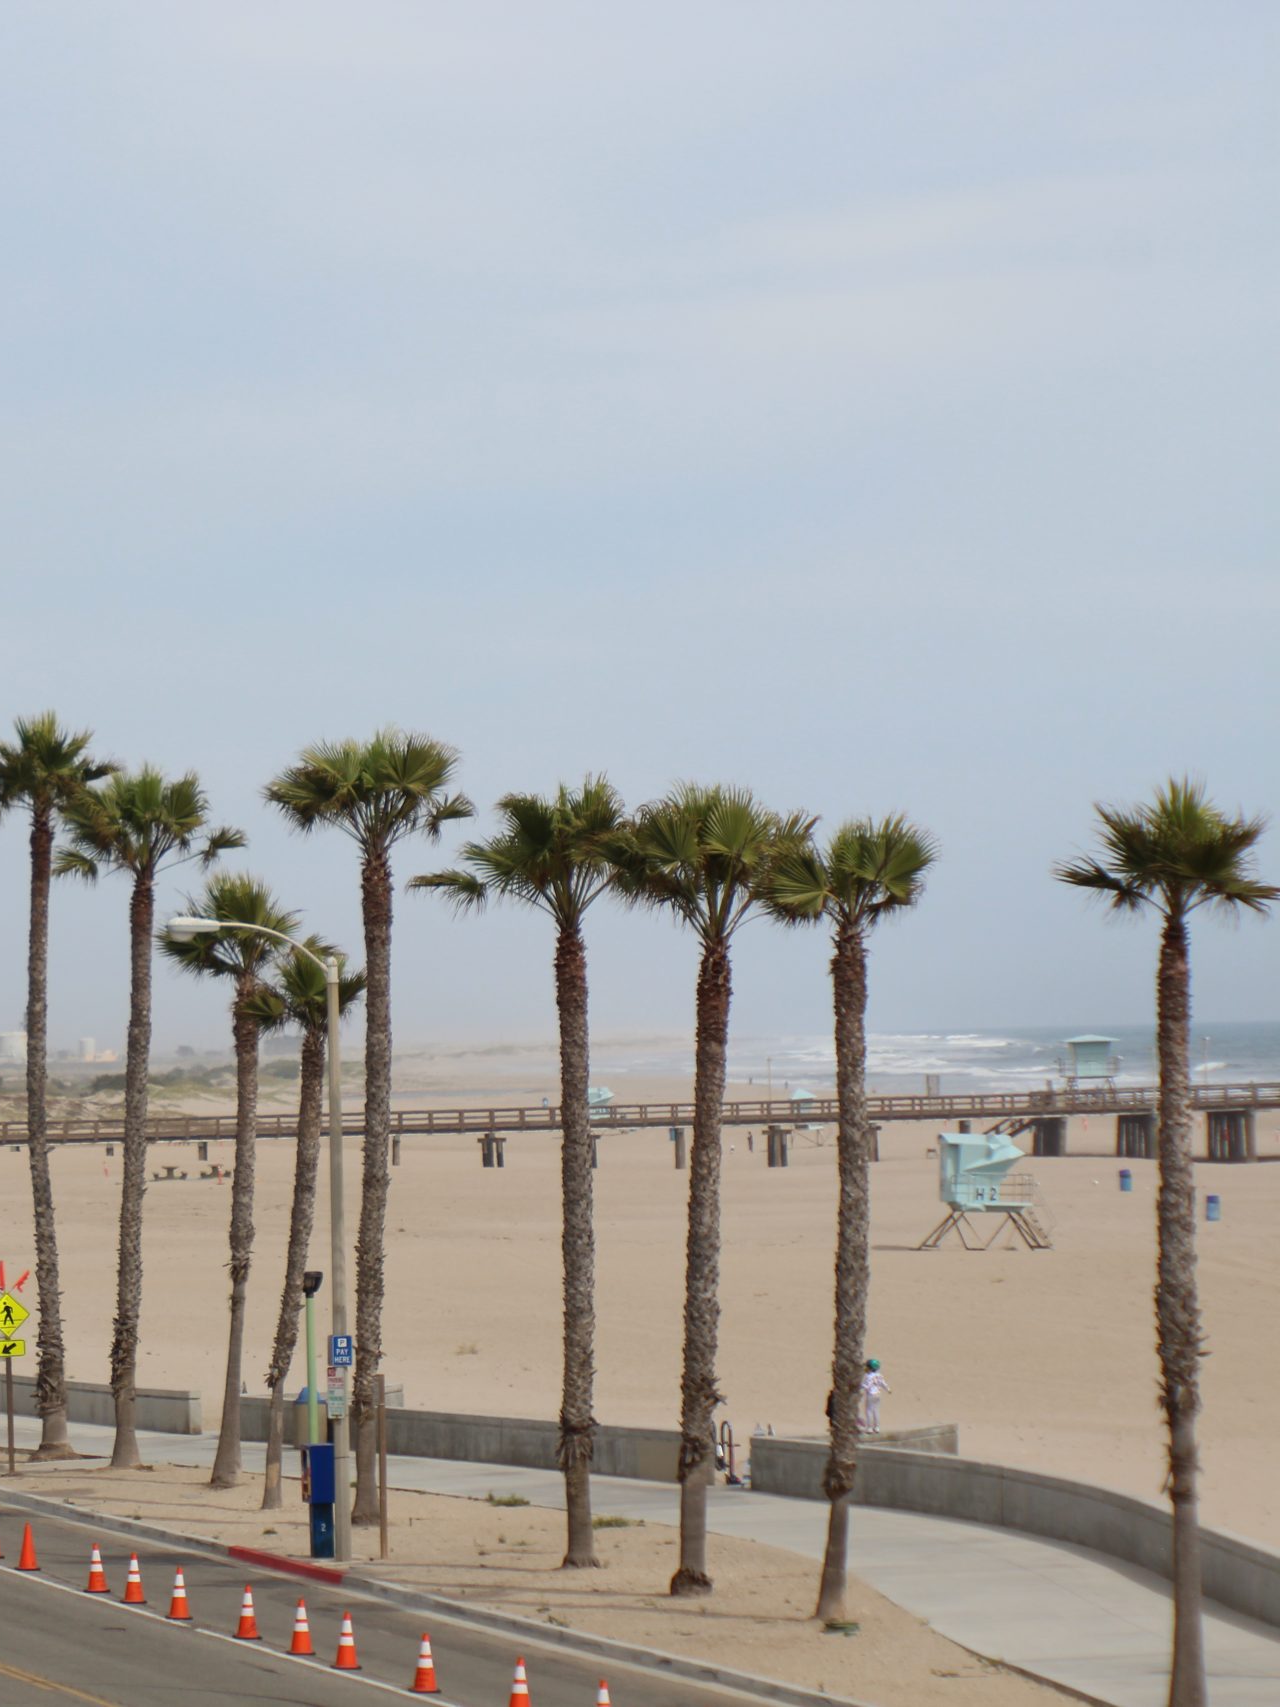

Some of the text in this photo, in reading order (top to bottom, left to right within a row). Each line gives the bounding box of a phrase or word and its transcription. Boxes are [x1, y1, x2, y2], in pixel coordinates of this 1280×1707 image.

[976, 1187, 997, 1201] H 2
[335, 1348, 349, 1356] PAY
